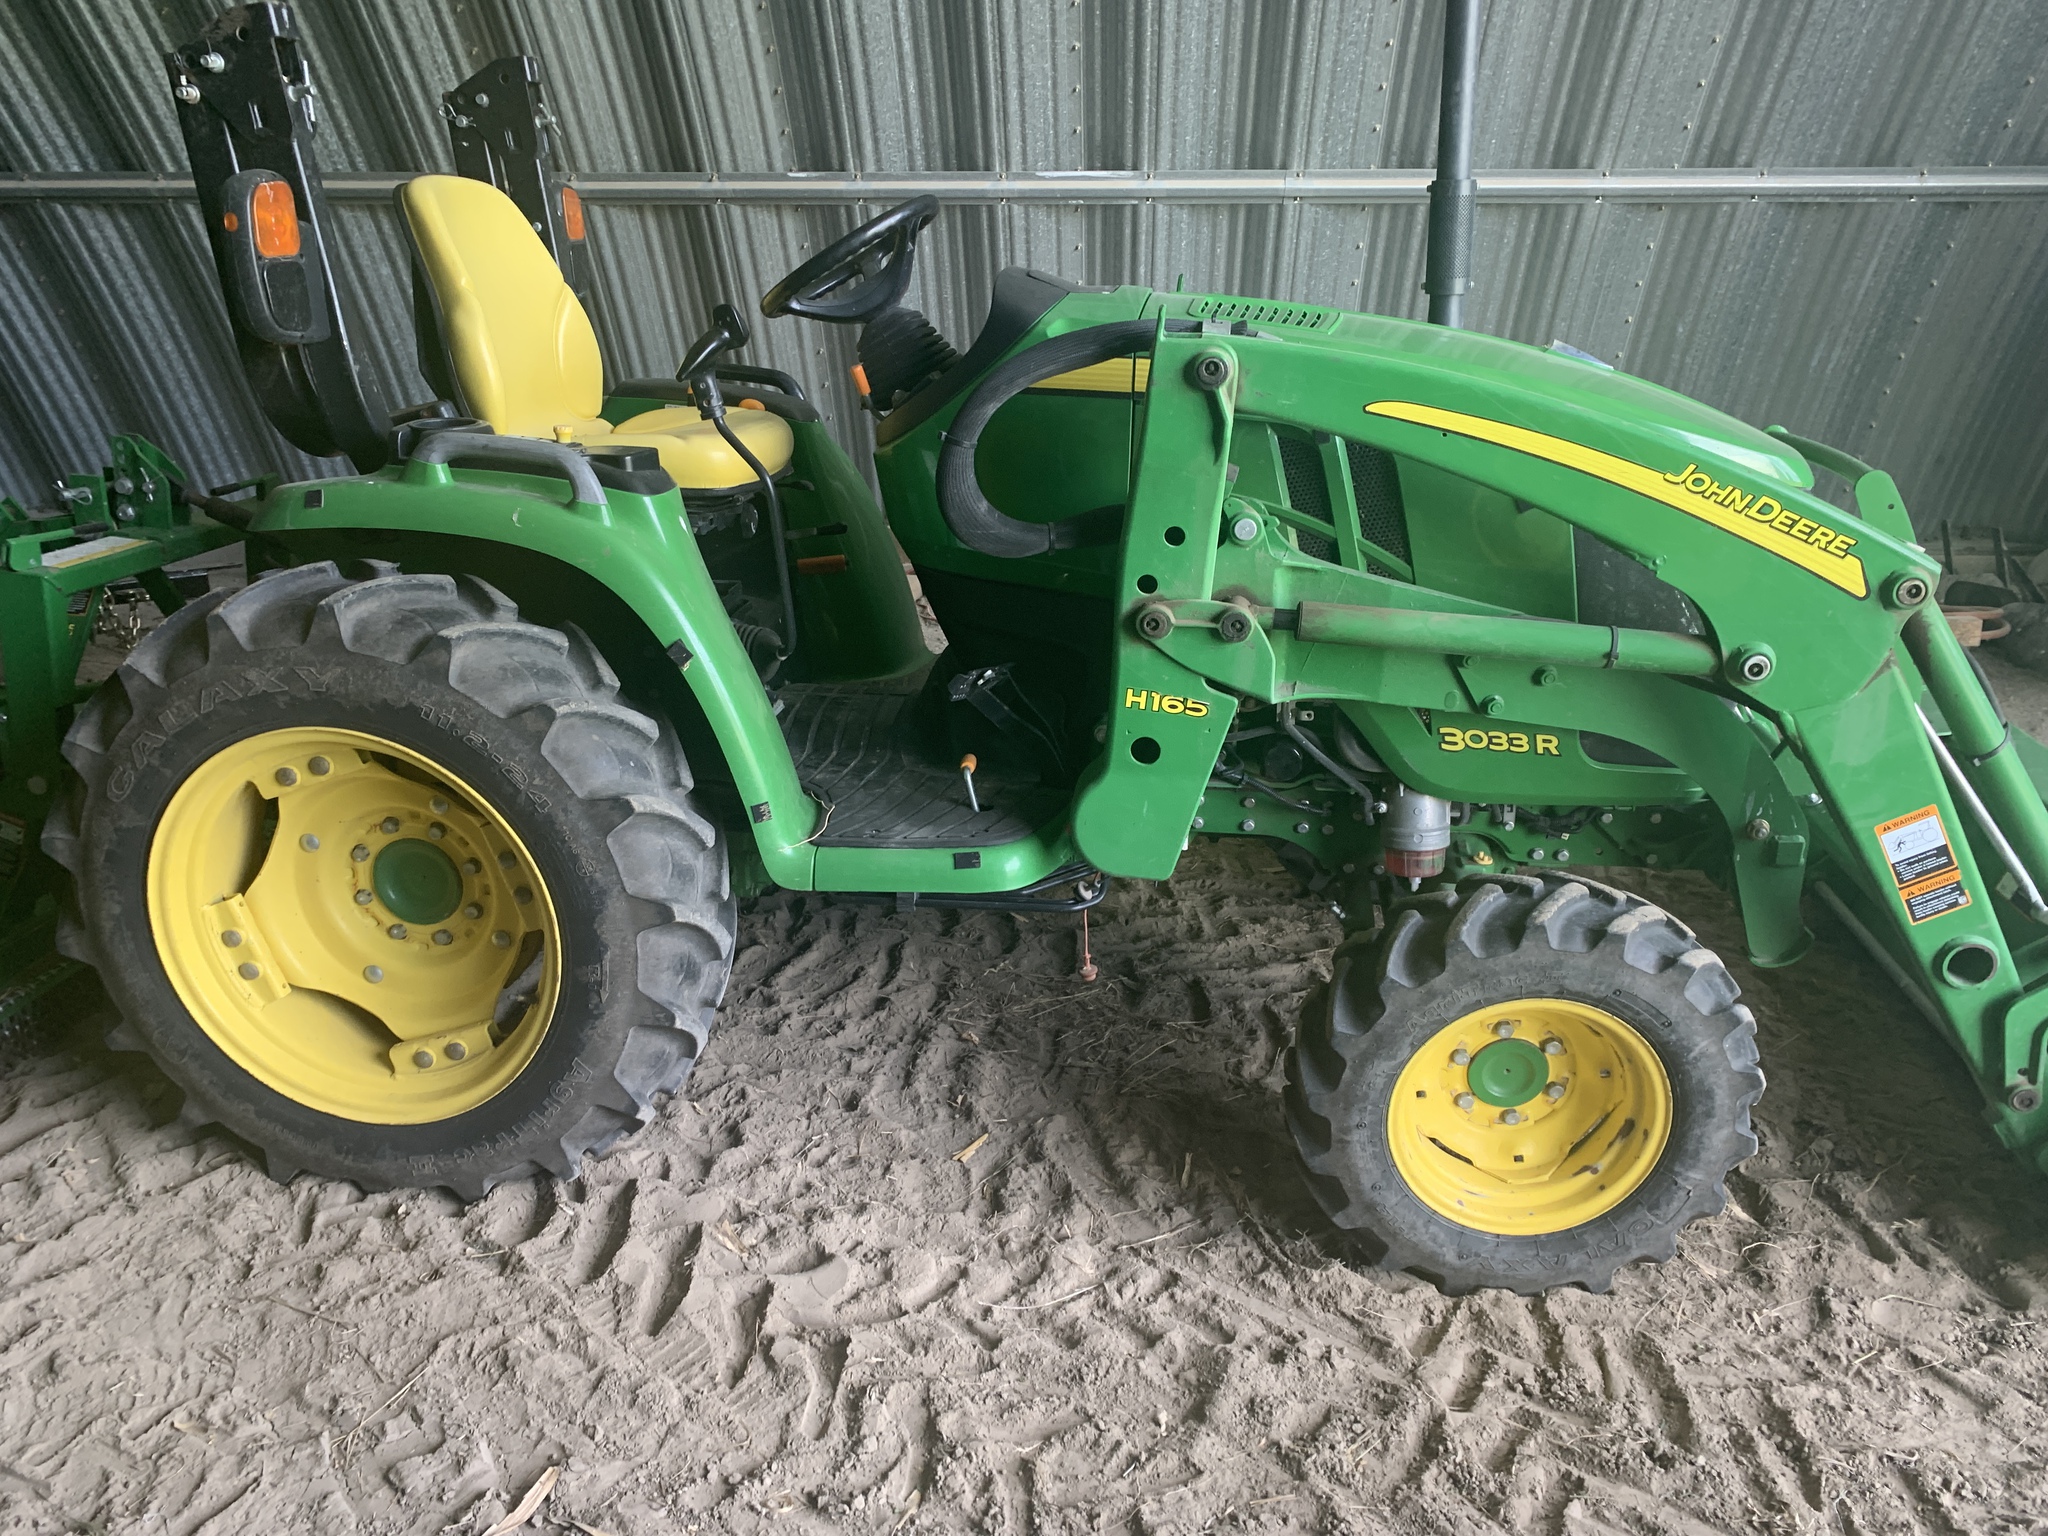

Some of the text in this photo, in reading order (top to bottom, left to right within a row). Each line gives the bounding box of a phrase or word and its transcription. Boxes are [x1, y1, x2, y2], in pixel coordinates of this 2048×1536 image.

[1125, 687, 1210, 718] H165
[106, 666, 347, 802] GALAXY
[1438, 726, 1562, 756] 3033 R
[420, 703, 552, 814] 11.2-24
[1891, 809, 1931, 828] WARNING
[1917, 874, 1956, 892] WARNING
